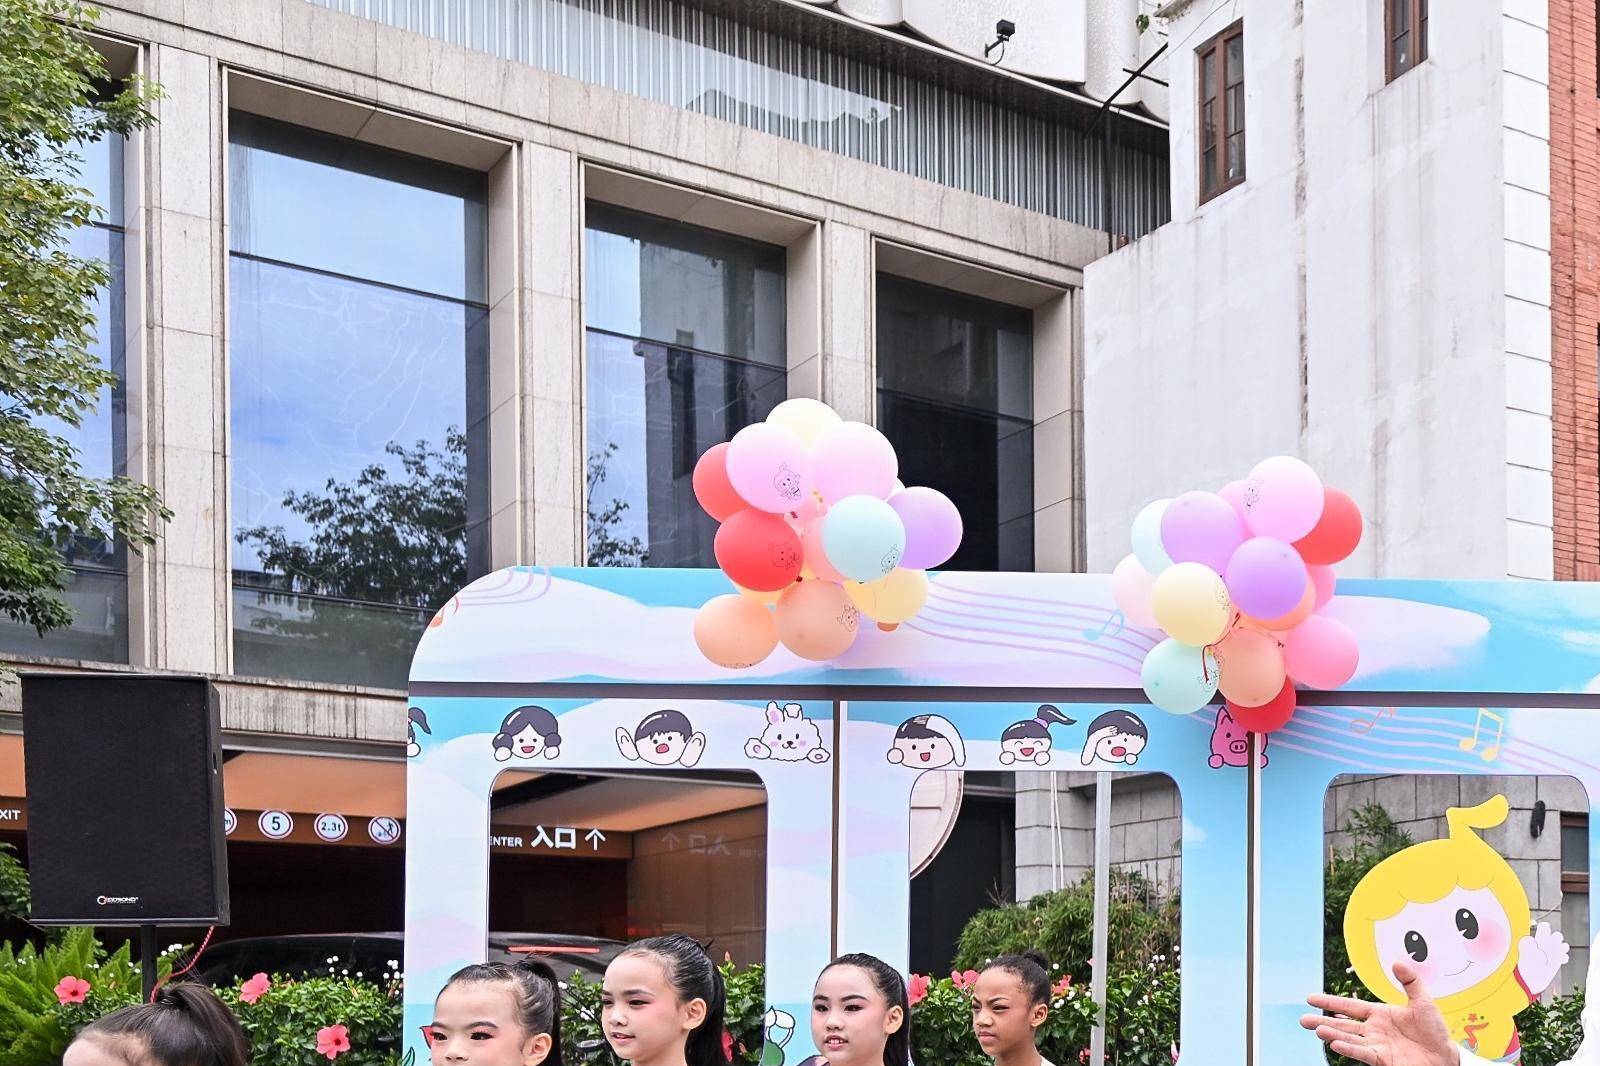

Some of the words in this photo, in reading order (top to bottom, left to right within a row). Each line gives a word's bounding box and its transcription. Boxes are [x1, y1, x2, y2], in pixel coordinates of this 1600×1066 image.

[271, 816, 281, 831] 5
[321, 821, 341, 832] 2.3t
[530, 825, 577, 849] 入口
